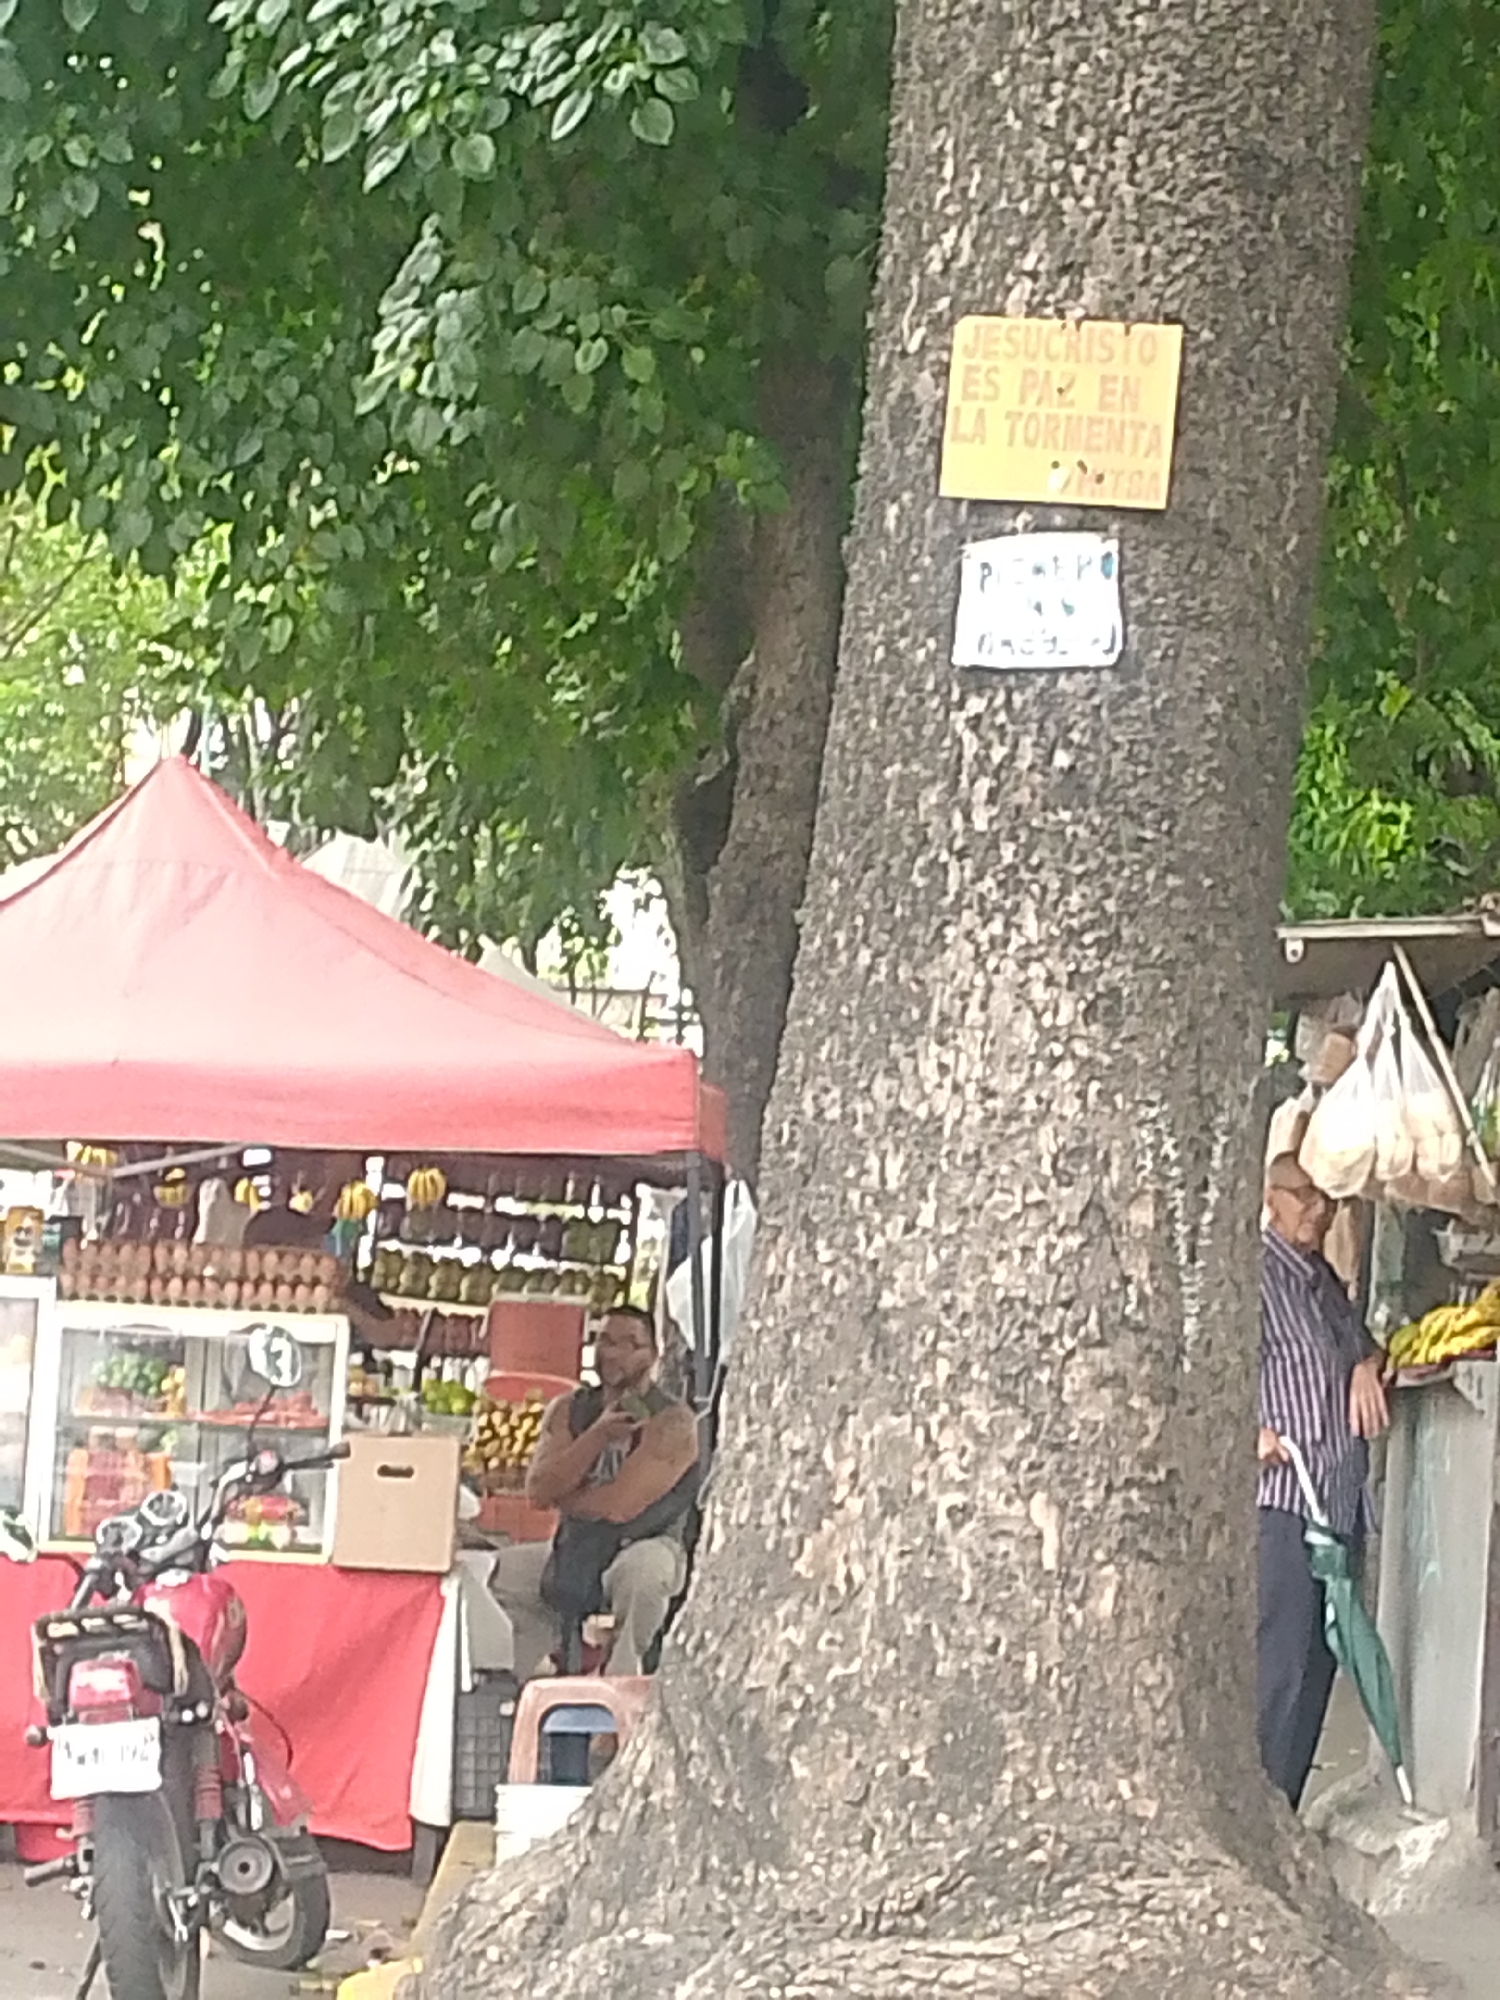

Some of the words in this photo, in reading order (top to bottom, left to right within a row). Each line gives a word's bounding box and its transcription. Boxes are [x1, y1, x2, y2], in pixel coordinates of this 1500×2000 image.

[962, 323, 1158, 366] JESUCRISTO
[961, 364, 1000, 402] ES
[1018, 368, 1077, 408] PAZ
[1098, 374, 1141, 413] EN
[950, 406, 986, 445] LA
[1005, 410, 1163, 459] TORMENTA
